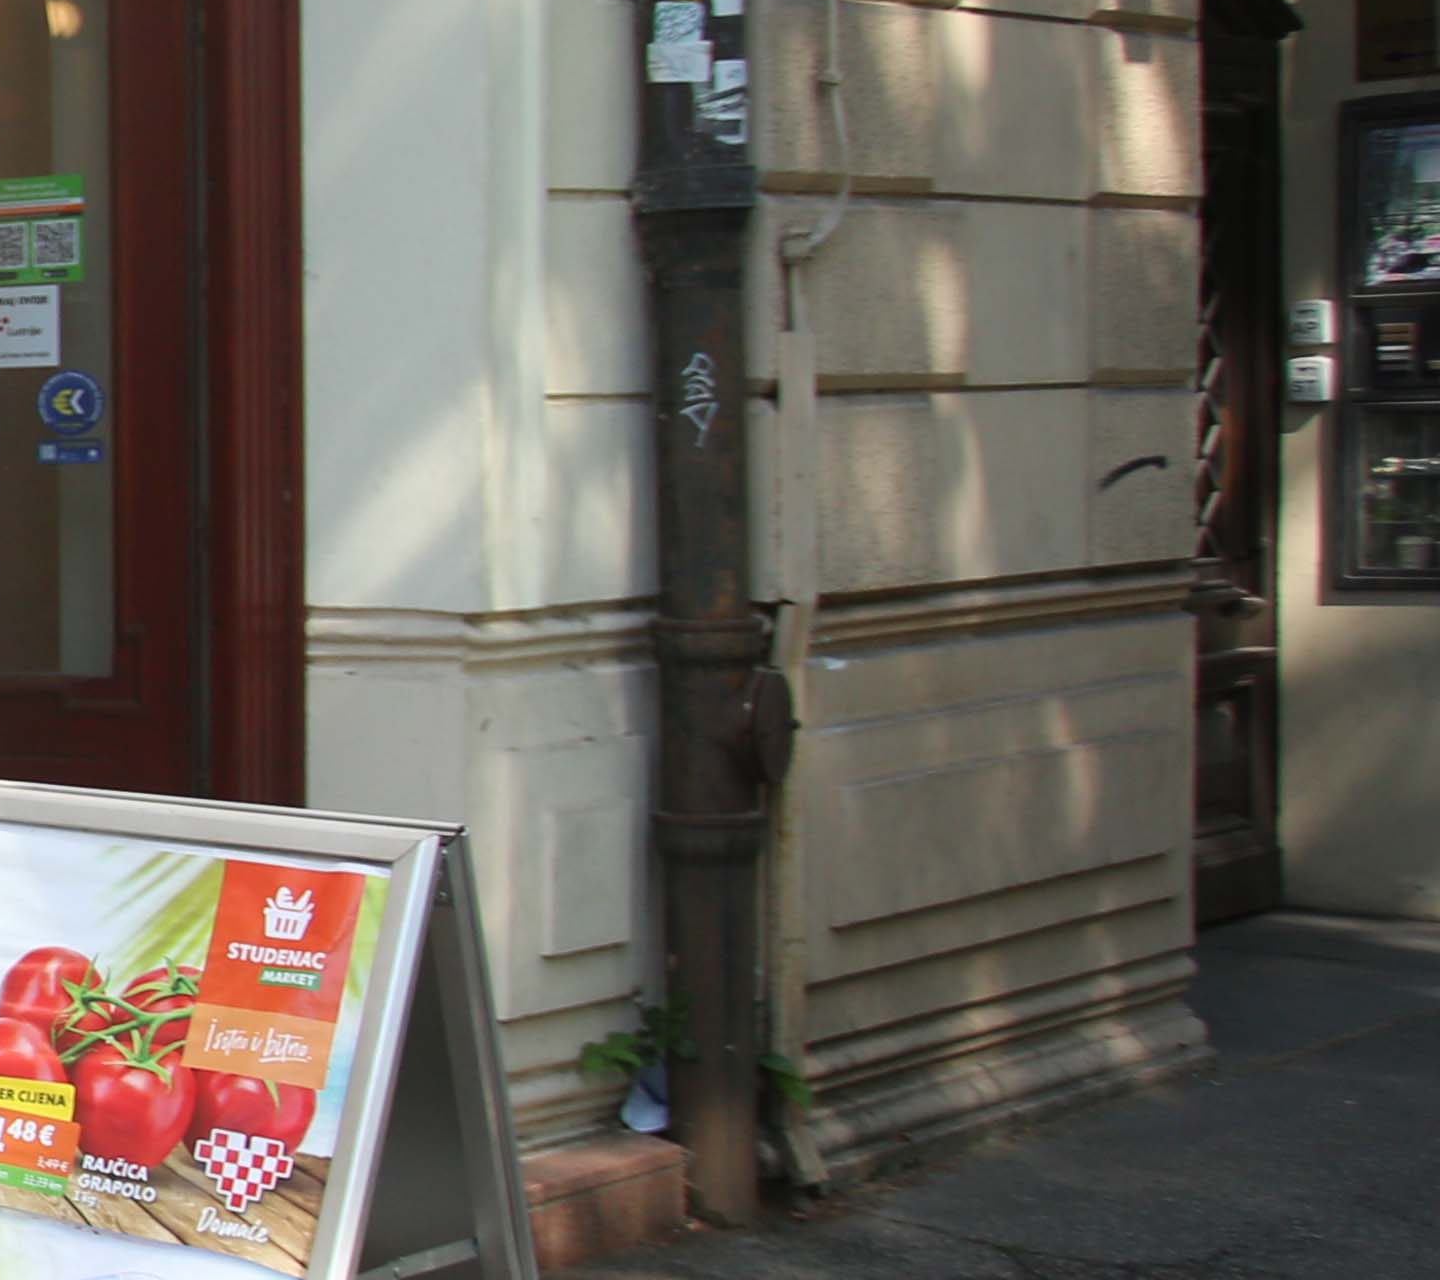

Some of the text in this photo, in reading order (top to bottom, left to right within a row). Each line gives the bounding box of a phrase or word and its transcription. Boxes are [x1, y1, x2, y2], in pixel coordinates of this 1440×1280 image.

[227, 942, 327, 970] STUDENAC
[260, 970, 318, 987] MARKET
[18, 1090, 66, 1108] CIJENA
[82, 1154, 149, 1182] RAJČICA
[77, 1173, 158, 1203] GRAPOLO
